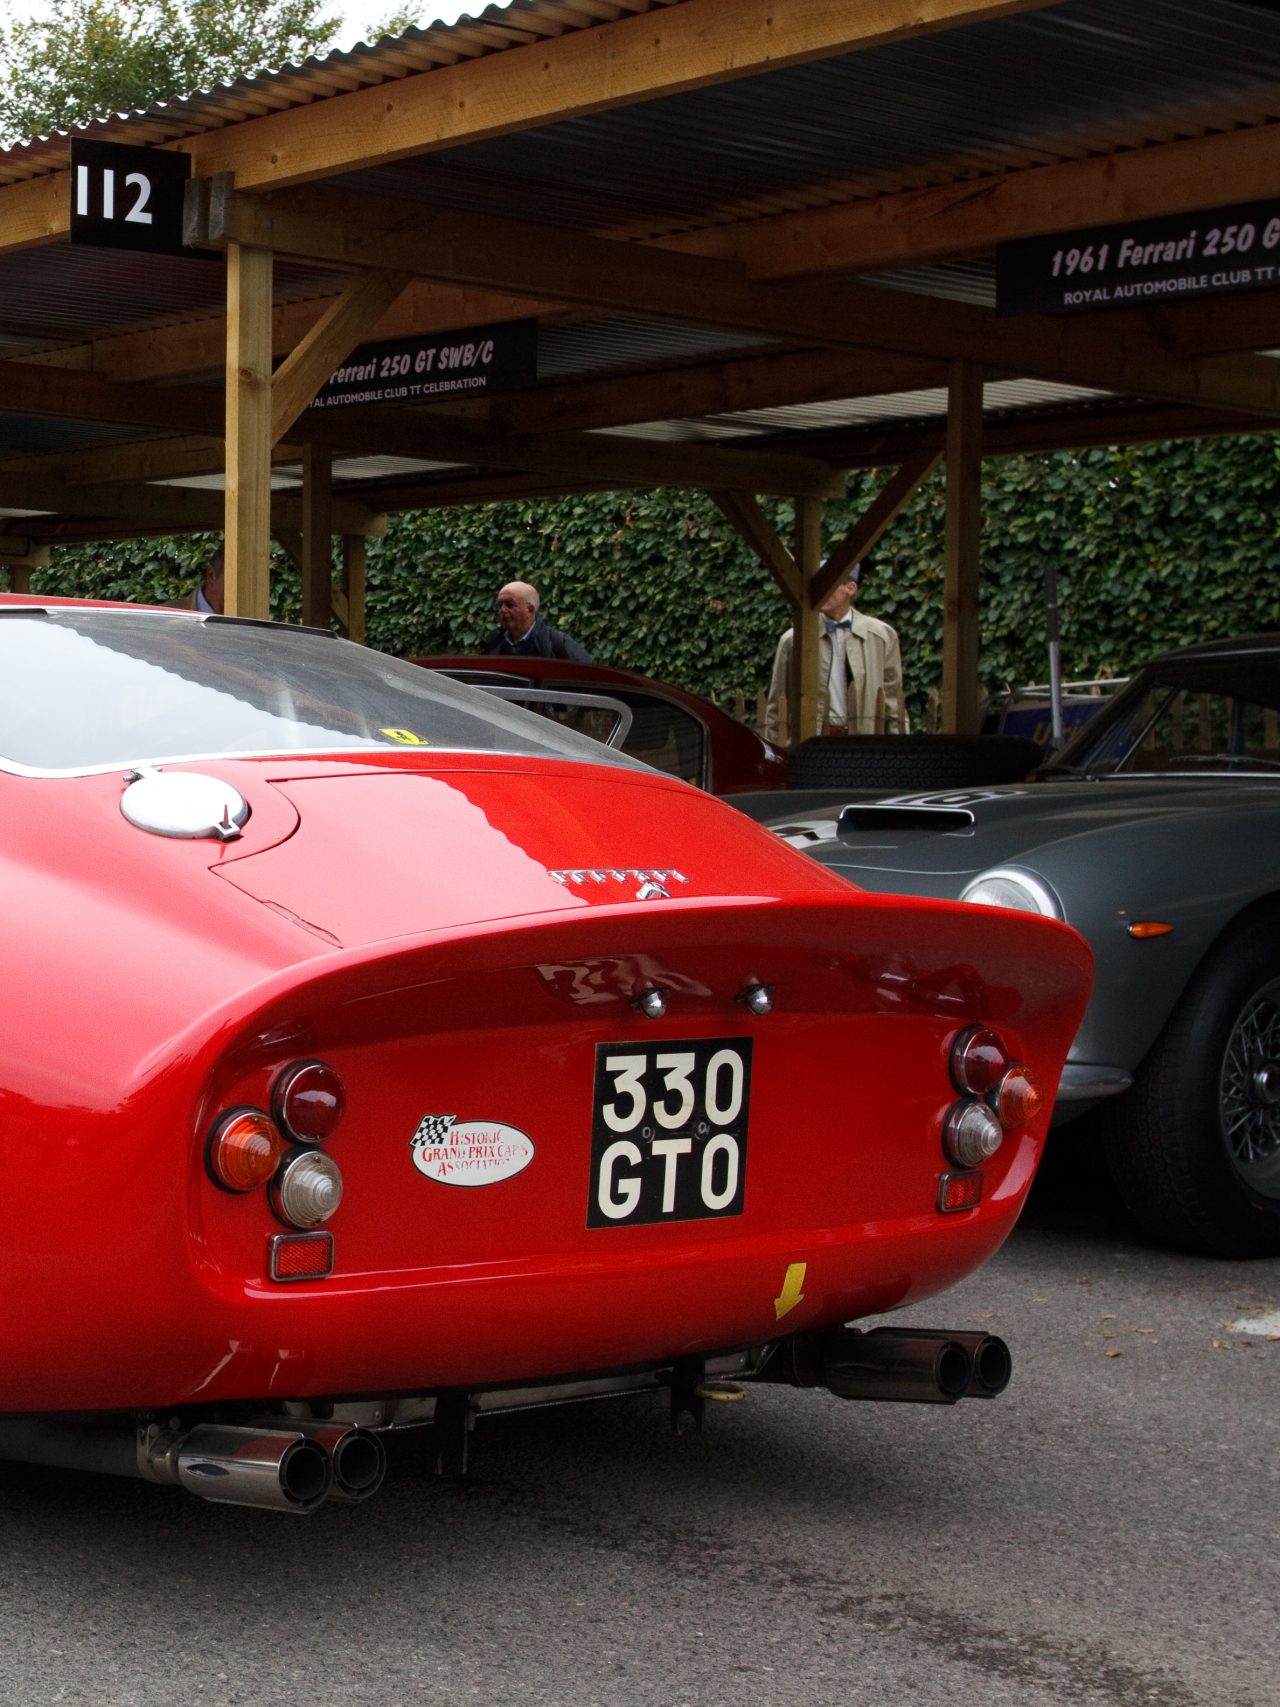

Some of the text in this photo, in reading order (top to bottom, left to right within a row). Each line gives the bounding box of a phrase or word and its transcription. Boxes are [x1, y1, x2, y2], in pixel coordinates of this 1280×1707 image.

[77, 165, 152, 224] 112
[1051, 244, 1109, 277] 1961
[1117, 230, 1197, 268] Ferrari
[1202, 223, 1256, 256] 250
[1064, 288, 1111, 305] ROYAL
[1113, 275, 1208, 299] AUTOMOBILE
[1211, 269, 1251, 287] CLUB
[1255, 266, 1274, 281] TT
[380, 354, 410, 377] 250
[414, 348, 439, 373] GT
[438, 340, 494, 370] SWB/C
[326, 389, 383, 406] AUTOMOBILE
[384, 386, 407, 398] CLUB
[410, 385, 421, 395] TT
[423, 376, 486, 393] CELEBRATION
[602, 1049, 744, 1133] 330
[422, 1145, 466, 1163] GRAND
[468, 1145, 495, 1159] PRIX
[597, 1133, 740, 1220] GTO
